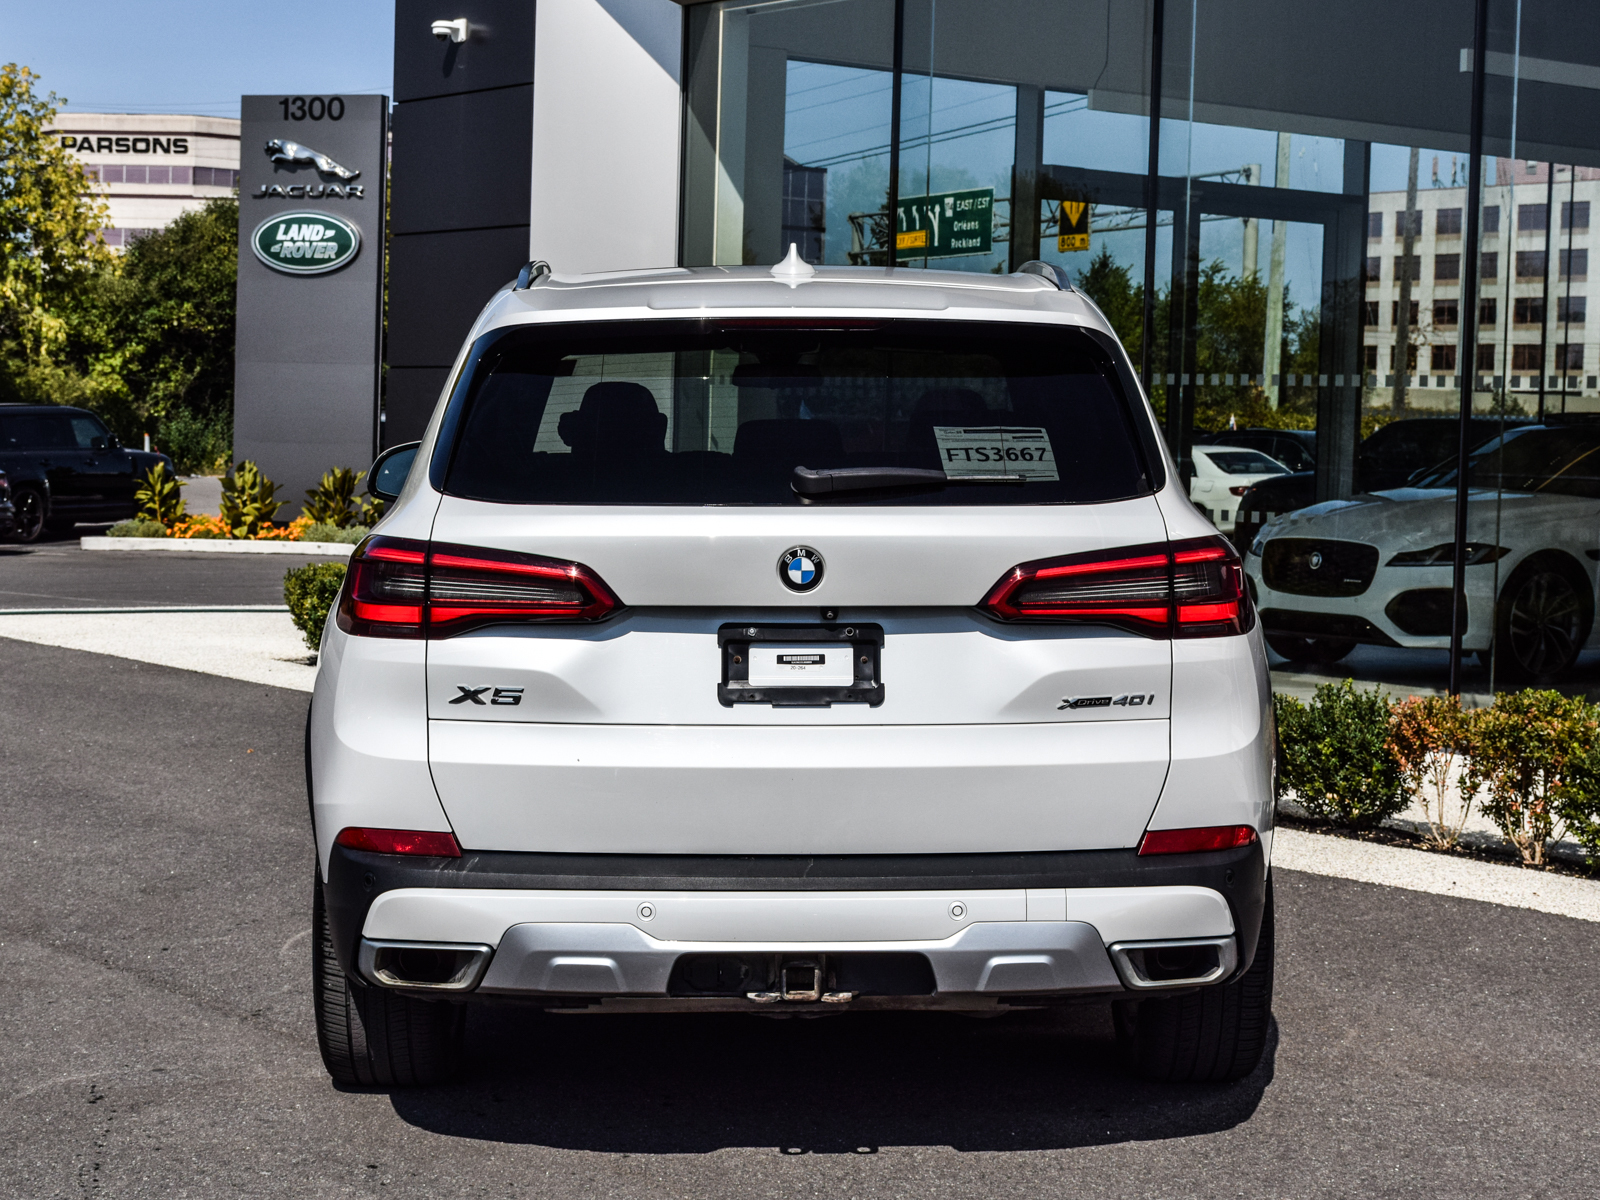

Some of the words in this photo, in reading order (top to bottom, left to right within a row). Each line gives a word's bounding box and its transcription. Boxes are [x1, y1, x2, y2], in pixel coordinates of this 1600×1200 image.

[279, 96, 344, 121] 1300
[61, 136, 189, 154] PARSONS
[252, 184, 364, 199] JAGUAR
[276, 223, 325, 241] LAND
[280, 241, 338, 259] ROVER
[1060, 236, 1076, 247] 800
[945, 447, 1046, 462] FTS3667
[784, 549, 820, 564] BMW
[447, 684, 525, 706] X5
